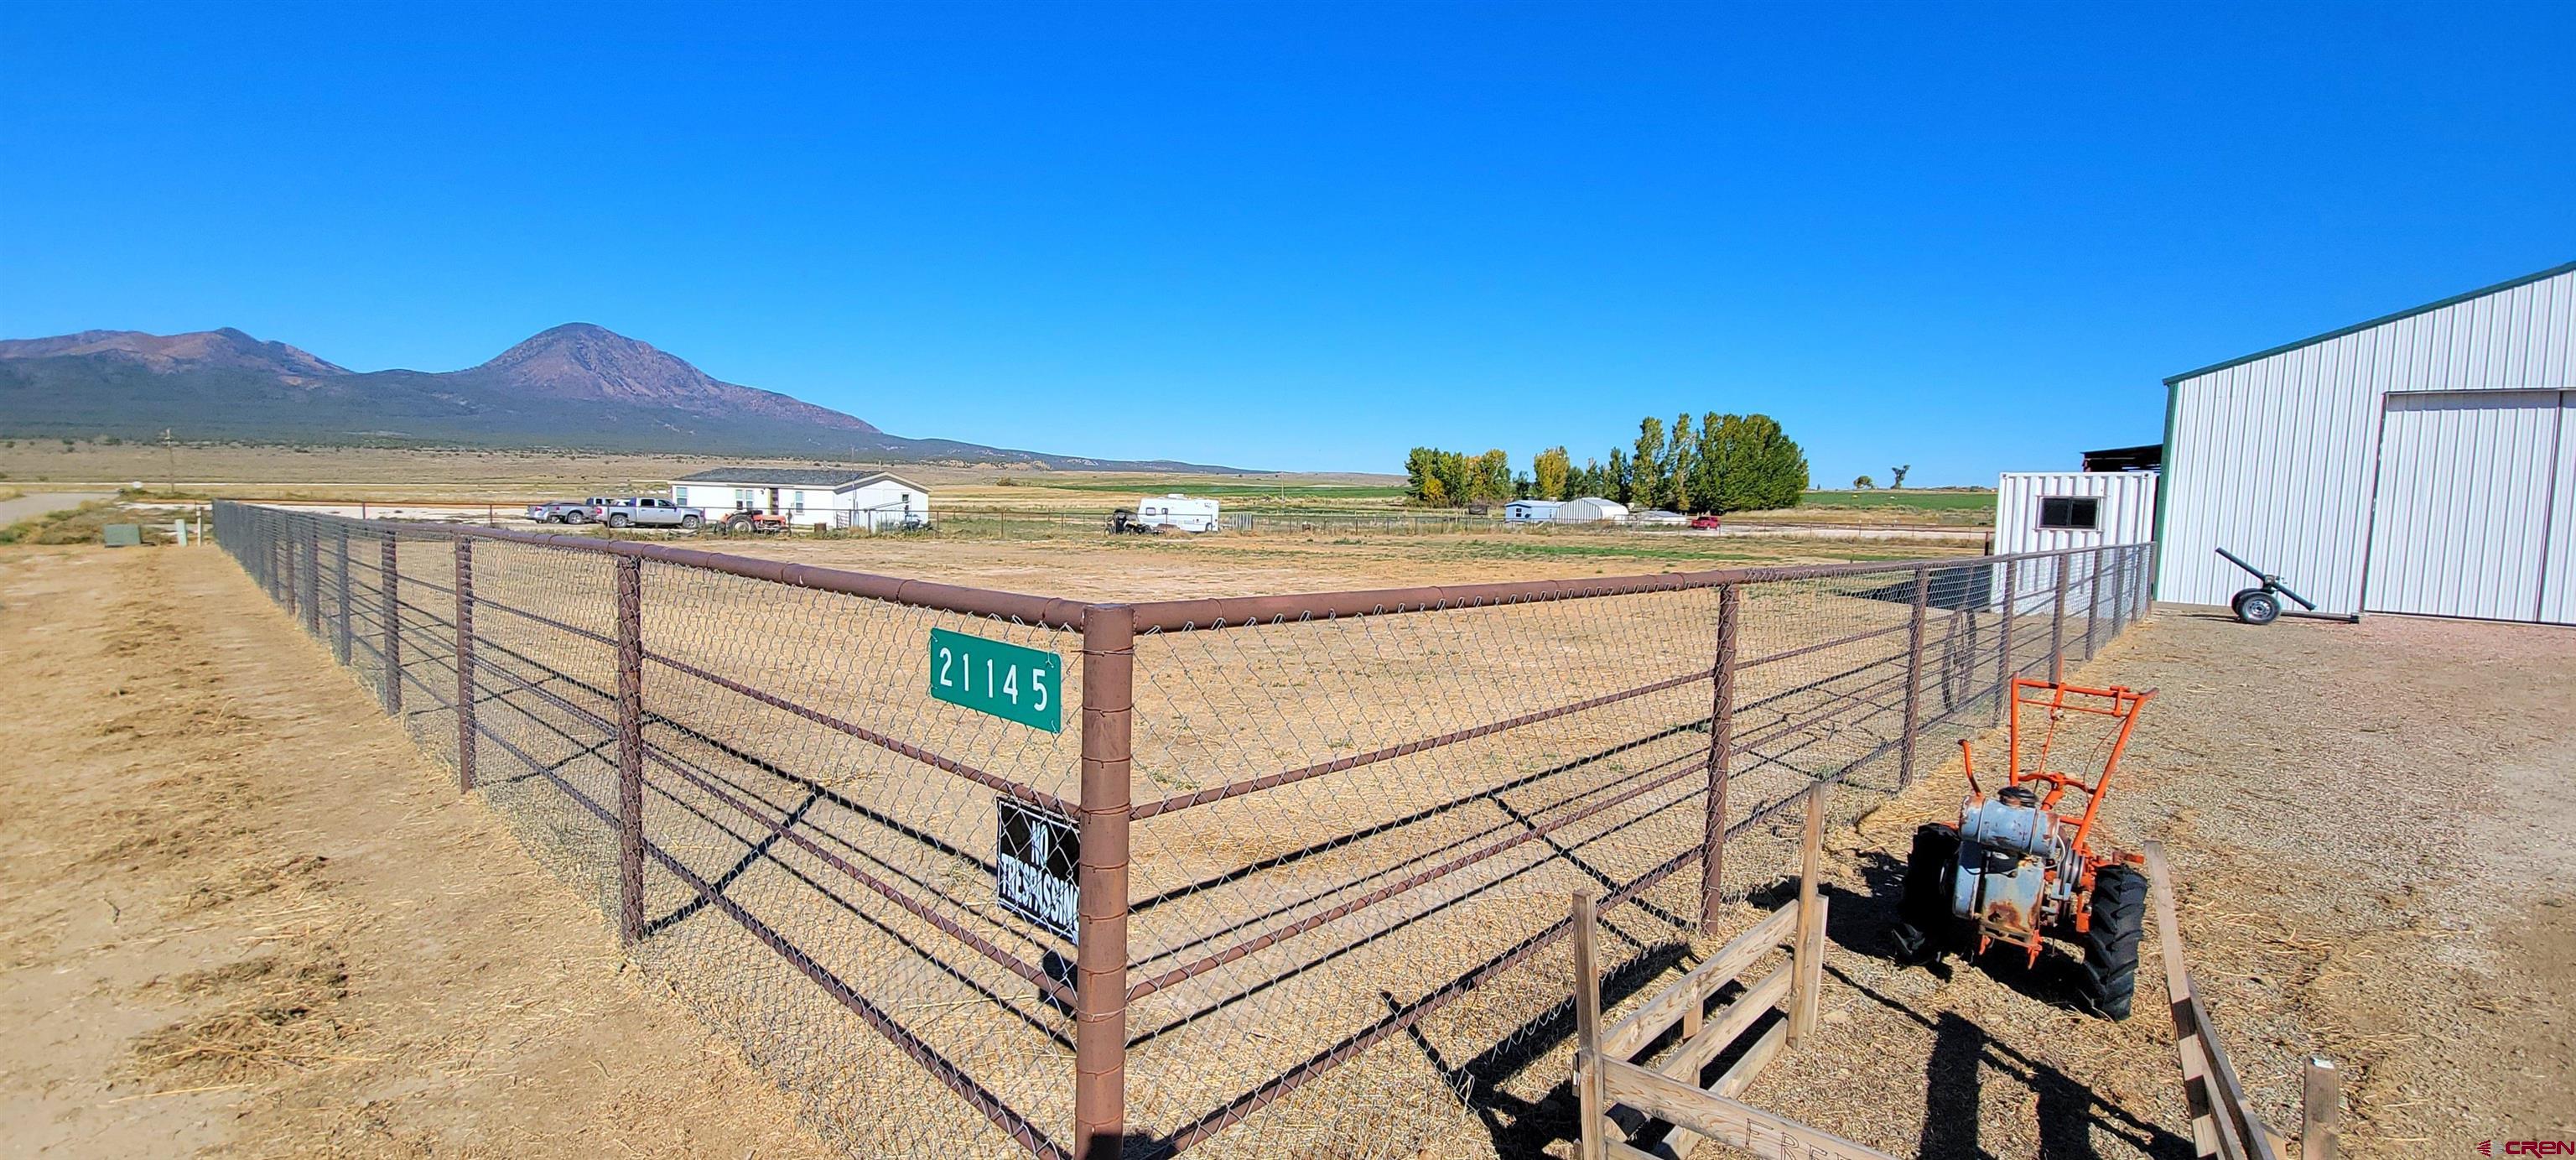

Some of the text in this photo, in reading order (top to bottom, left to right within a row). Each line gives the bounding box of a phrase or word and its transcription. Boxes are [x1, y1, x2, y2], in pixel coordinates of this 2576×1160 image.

[939, 647, 1048, 711] 21145
[1031, 820, 1049, 867] NO
[1745, 1118, 1852, 1160] FRE
